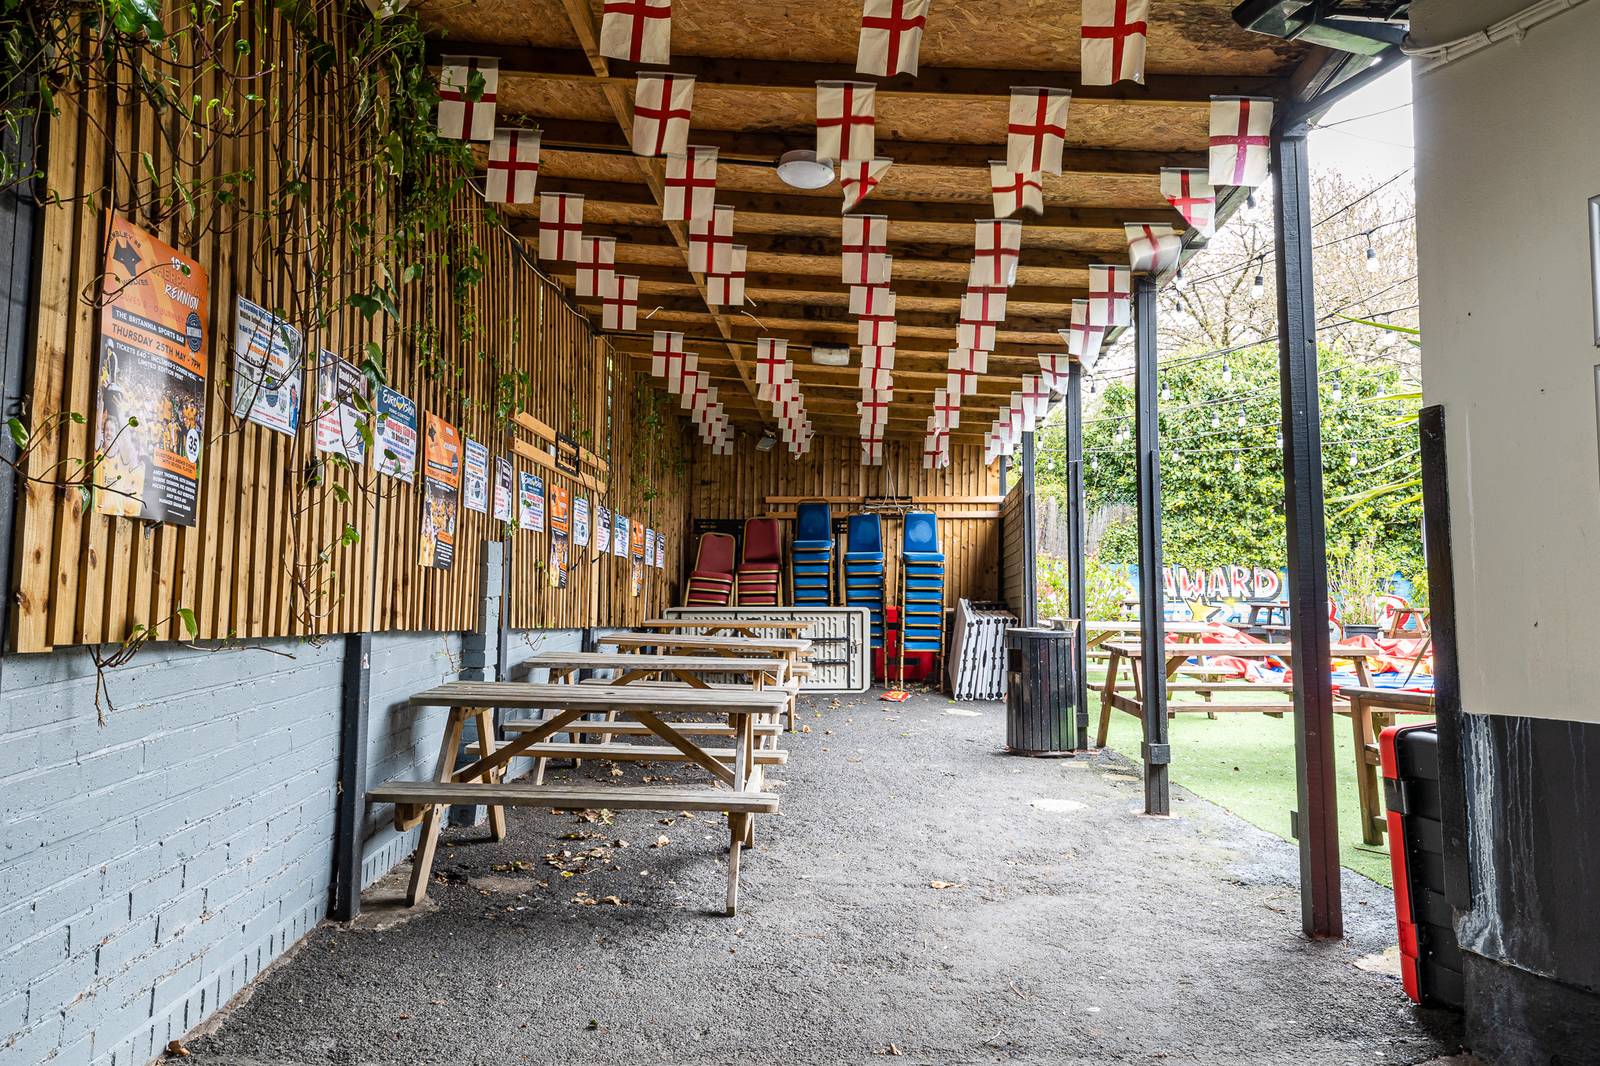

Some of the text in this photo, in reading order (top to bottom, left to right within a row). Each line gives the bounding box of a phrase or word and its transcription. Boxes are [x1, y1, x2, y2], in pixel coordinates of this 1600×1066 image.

[164, 284, 200, 310] REUNION
[116, 309, 128, 320] THE
[128, 314, 157, 332] BRITANNIA
[158, 326, 176, 340] SPORTS
[176, 334, 185, 344] BAR
[112, 323, 201, 370] THURSDAY 25TH MAY 7PM
[116, 342, 136, 354] TICKETS
[188, 435, 198, 452] 35
